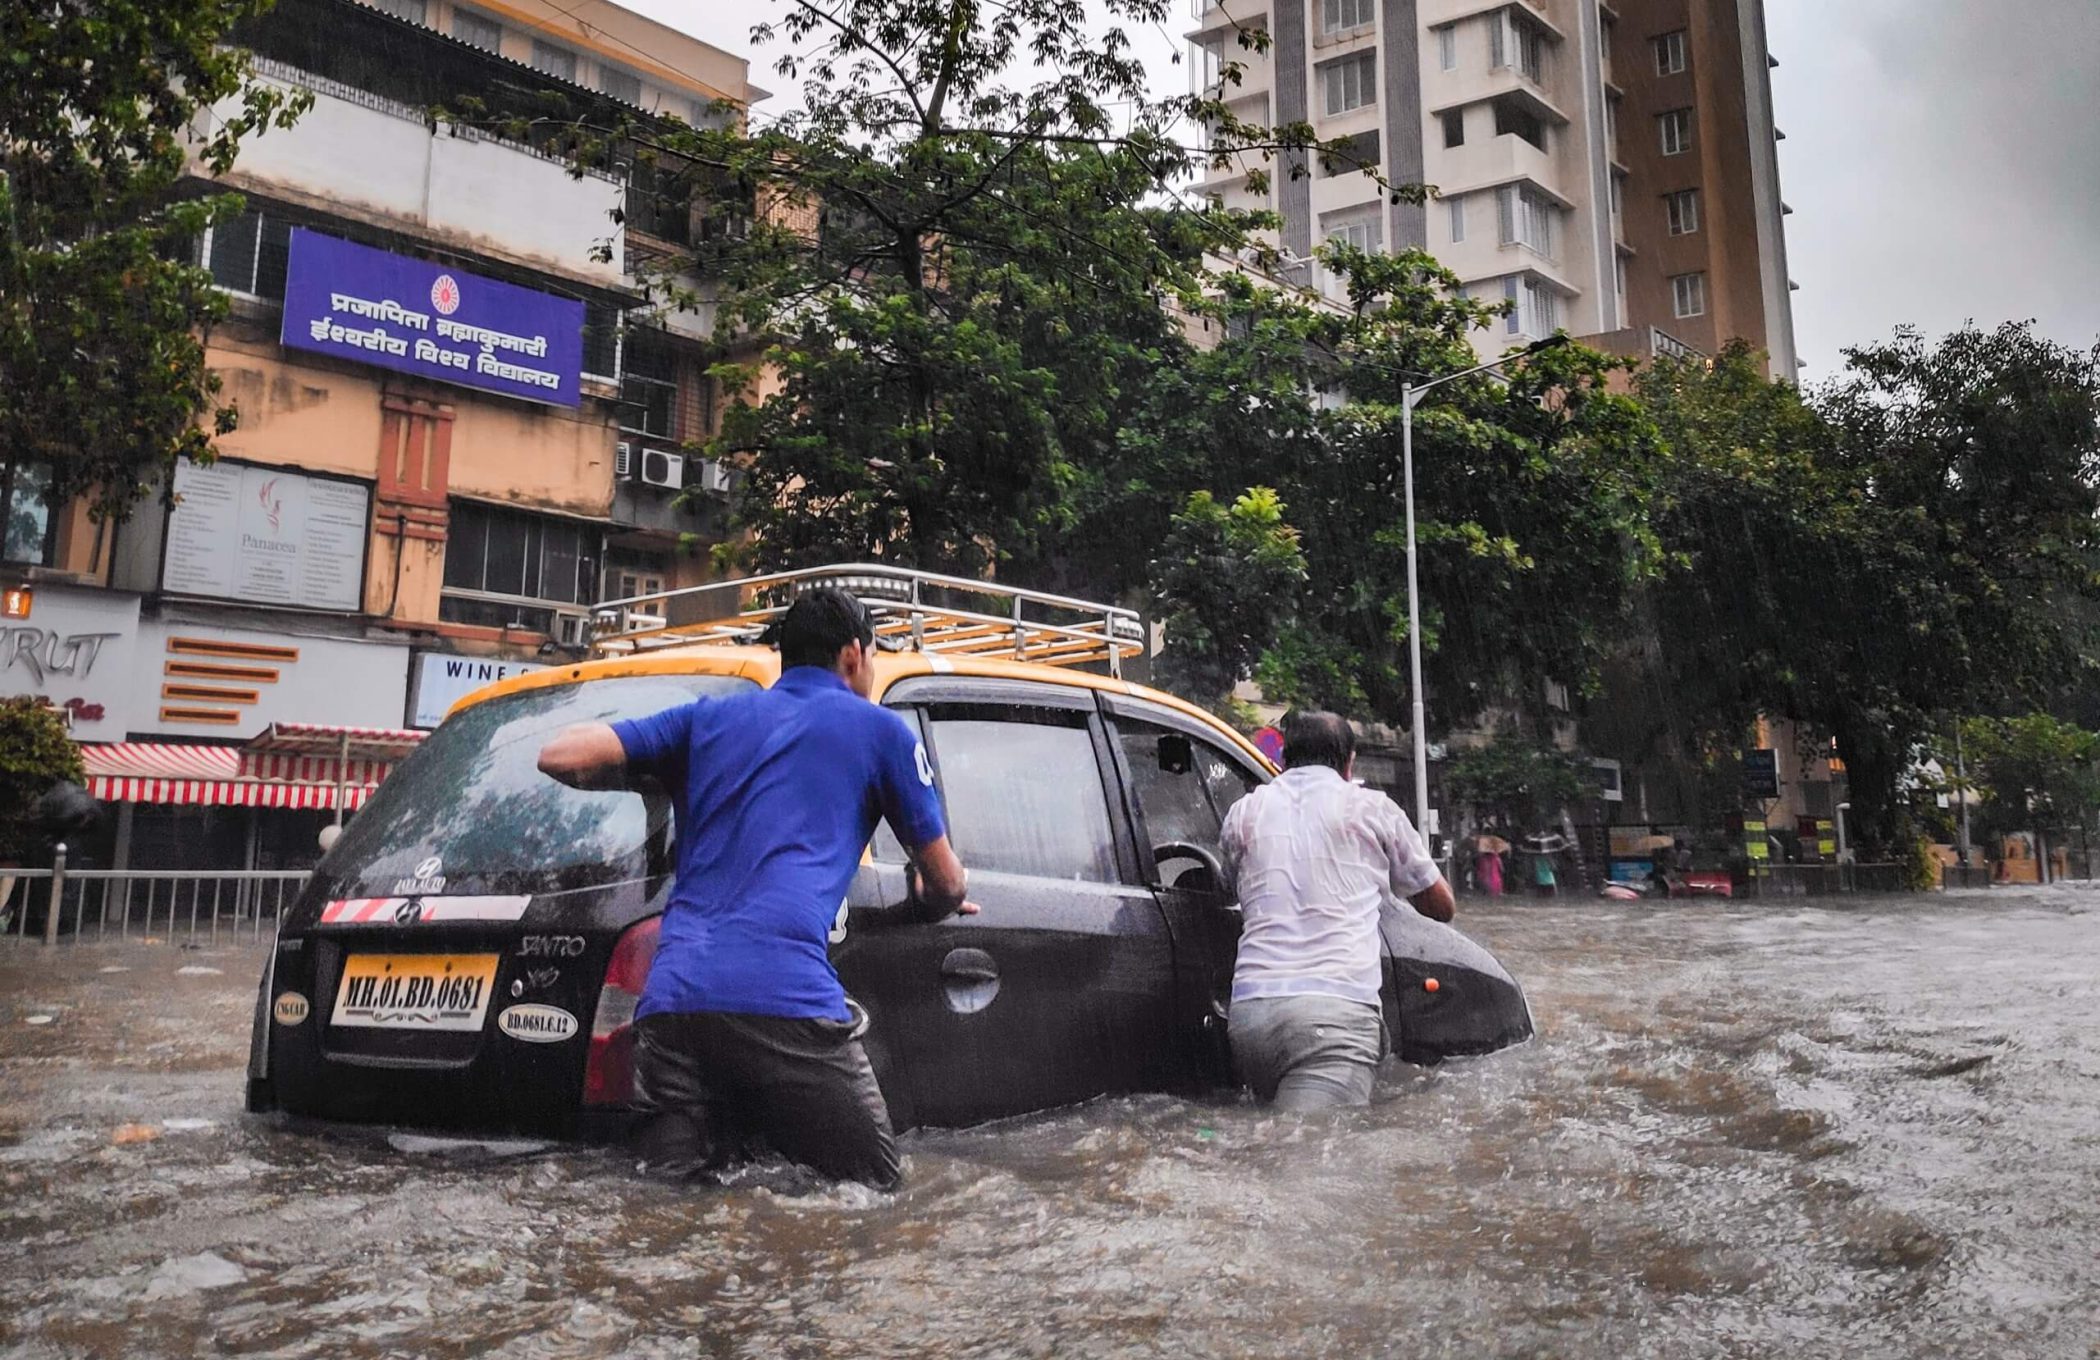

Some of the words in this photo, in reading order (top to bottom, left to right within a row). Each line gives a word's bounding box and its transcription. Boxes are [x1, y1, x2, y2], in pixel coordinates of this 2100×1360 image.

[330, 292, 429, 331] प्रजापिता
[435, 317, 548, 358] ब्रह्माकुमारी
[309, 317, 408, 357] ईश्वरीय
[414, 342, 471, 371] विश्व
[476, 353, 560, 390] विद्यालय
[242, 533, 296, 554] Panacea
[446, 660, 506, 681] WINE
[343, 975, 485, 1010] MH.01.BD.0681
